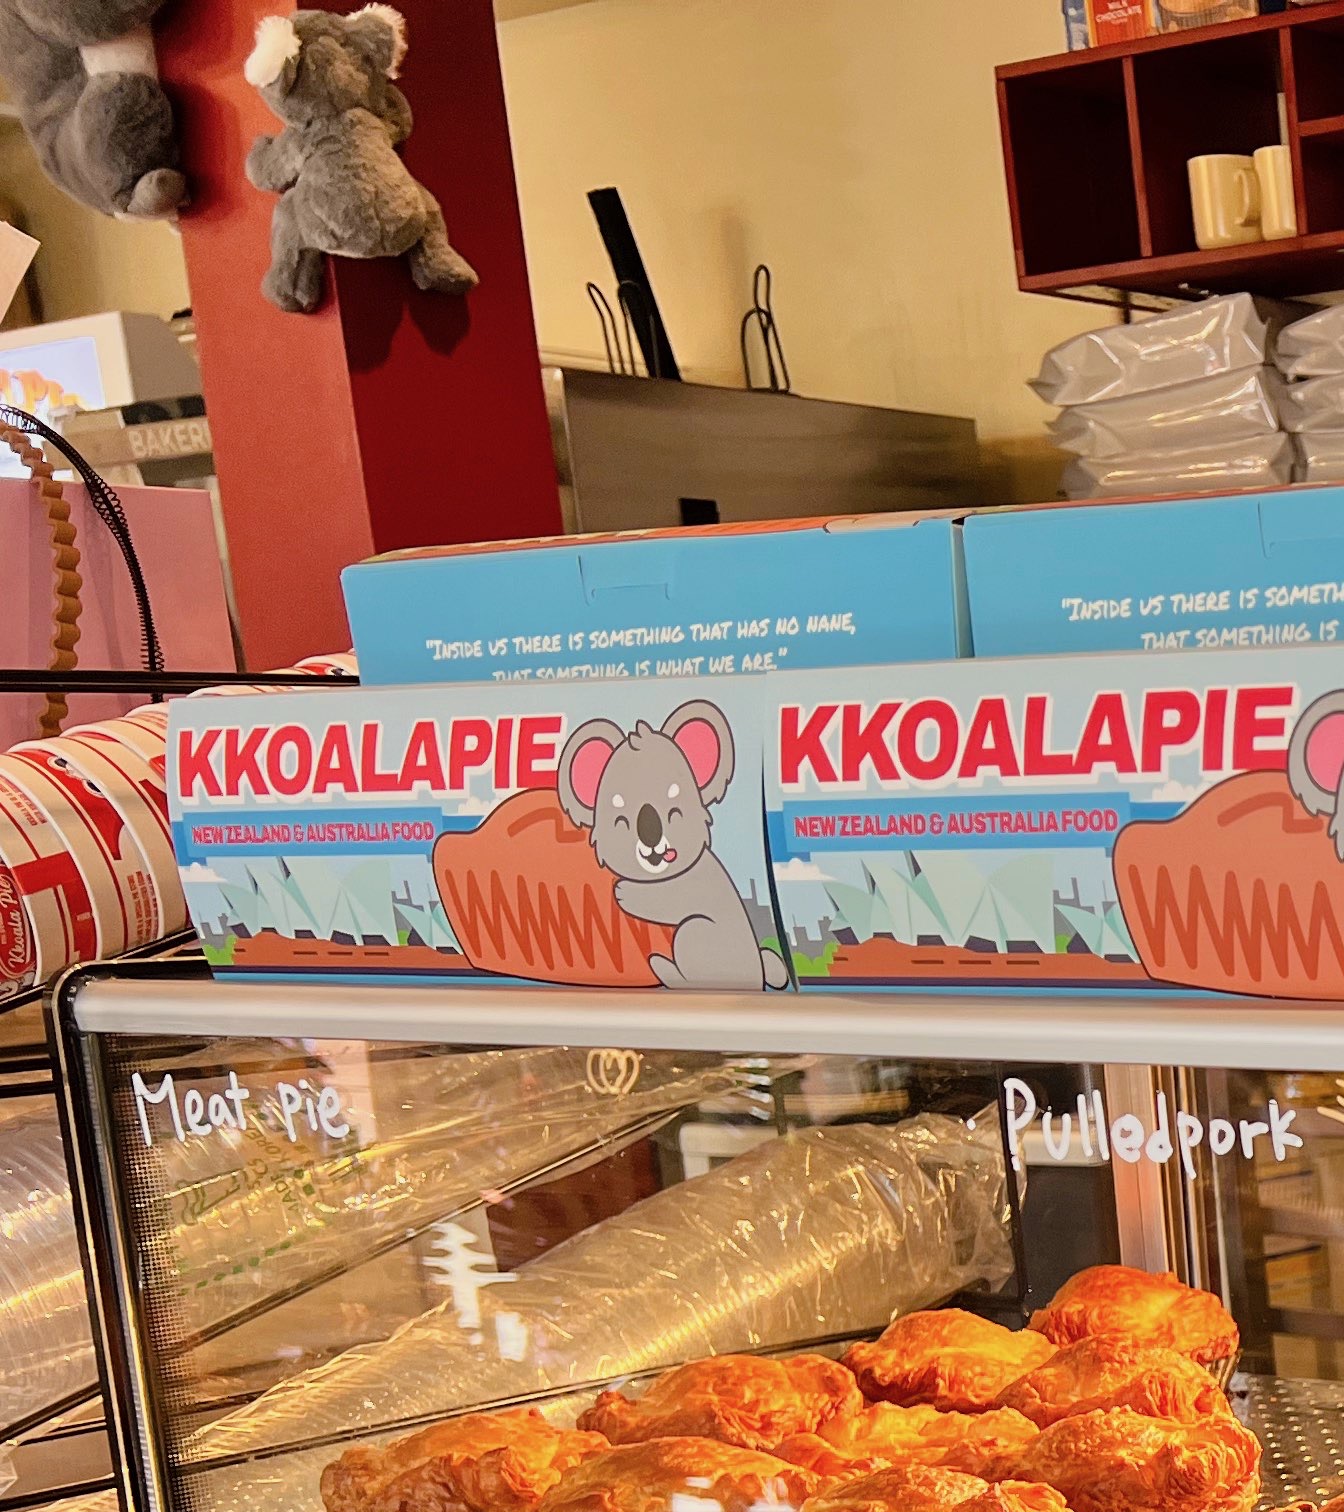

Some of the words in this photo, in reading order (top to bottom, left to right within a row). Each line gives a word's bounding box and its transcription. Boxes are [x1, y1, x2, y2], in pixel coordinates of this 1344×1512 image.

[1139, 594, 1166, 616] US
[1169, 589, 1231, 615] THERE
[1239, 588, 1258, 610] IS
[487, 636, 508, 657] US
[512, 633, 562, 655] THERE
[568, 631, 585, 652] IS
[588, 623, 686, 650] SOMETHING
[690, 619, 735, 642] THAT
[736, 617, 770, 637] HAS
[775, 615, 801, 636] NO
[1141, 629, 1191, 651] THAT
[1194, 621, 1312, 650] SOMETHING
[1319, 619, 1340, 642] IS
[492, 667, 531, 682] THAT
[634, 659, 650, 678] IS
[654, 655, 704, 677] WHAT
[708, 653, 737, 675] WE
[781, 686, 1293, 784] KKOALAPIE
[179, 715, 563, 798] KKOALAPIE
[293, 823, 305, 842] &
[306, 821, 391, 843] AUSTRALIA
[391, 820, 436, 842] FOOD
[929, 813, 945, 835] &
[946, 810, 1061, 836] AUSTRALIA
[1061, 808, 1119, 833] FOOD
[132, 1070, 250, 1148] Meat
[1003, 1076, 1305, 1181] Pulledpork
